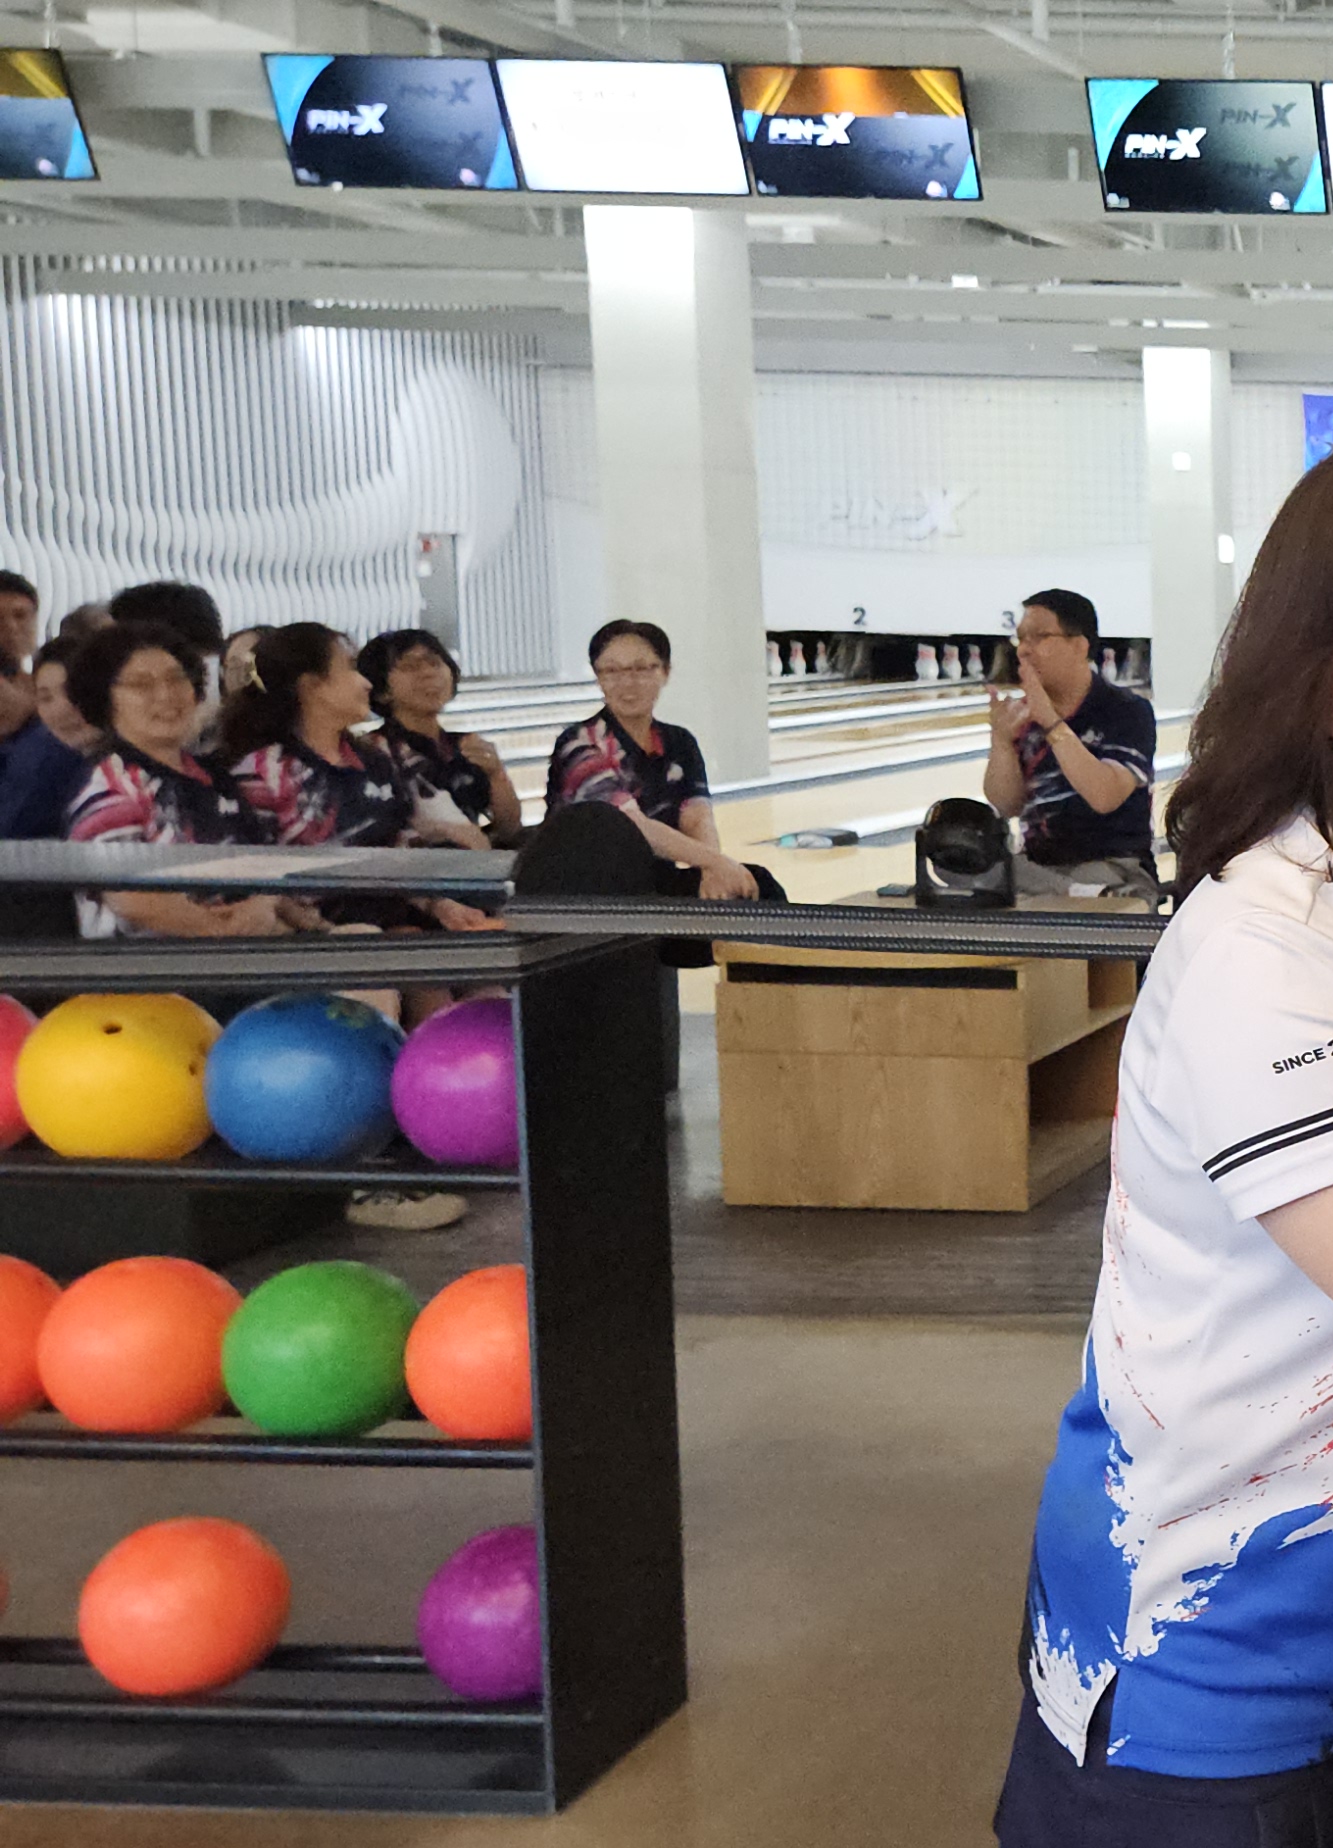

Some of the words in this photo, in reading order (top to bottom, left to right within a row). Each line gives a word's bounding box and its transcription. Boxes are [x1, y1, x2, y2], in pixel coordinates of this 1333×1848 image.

[306, 102, 387, 135] PIN-X
[768, 111, 855, 146] PIN-X
[1124, 127, 1206, 160] PIN-X
[852, 607, 866, 626] 2
[1001, 611, 1016, 630] 3
[1272, 1047, 1327, 1074] SINCE
